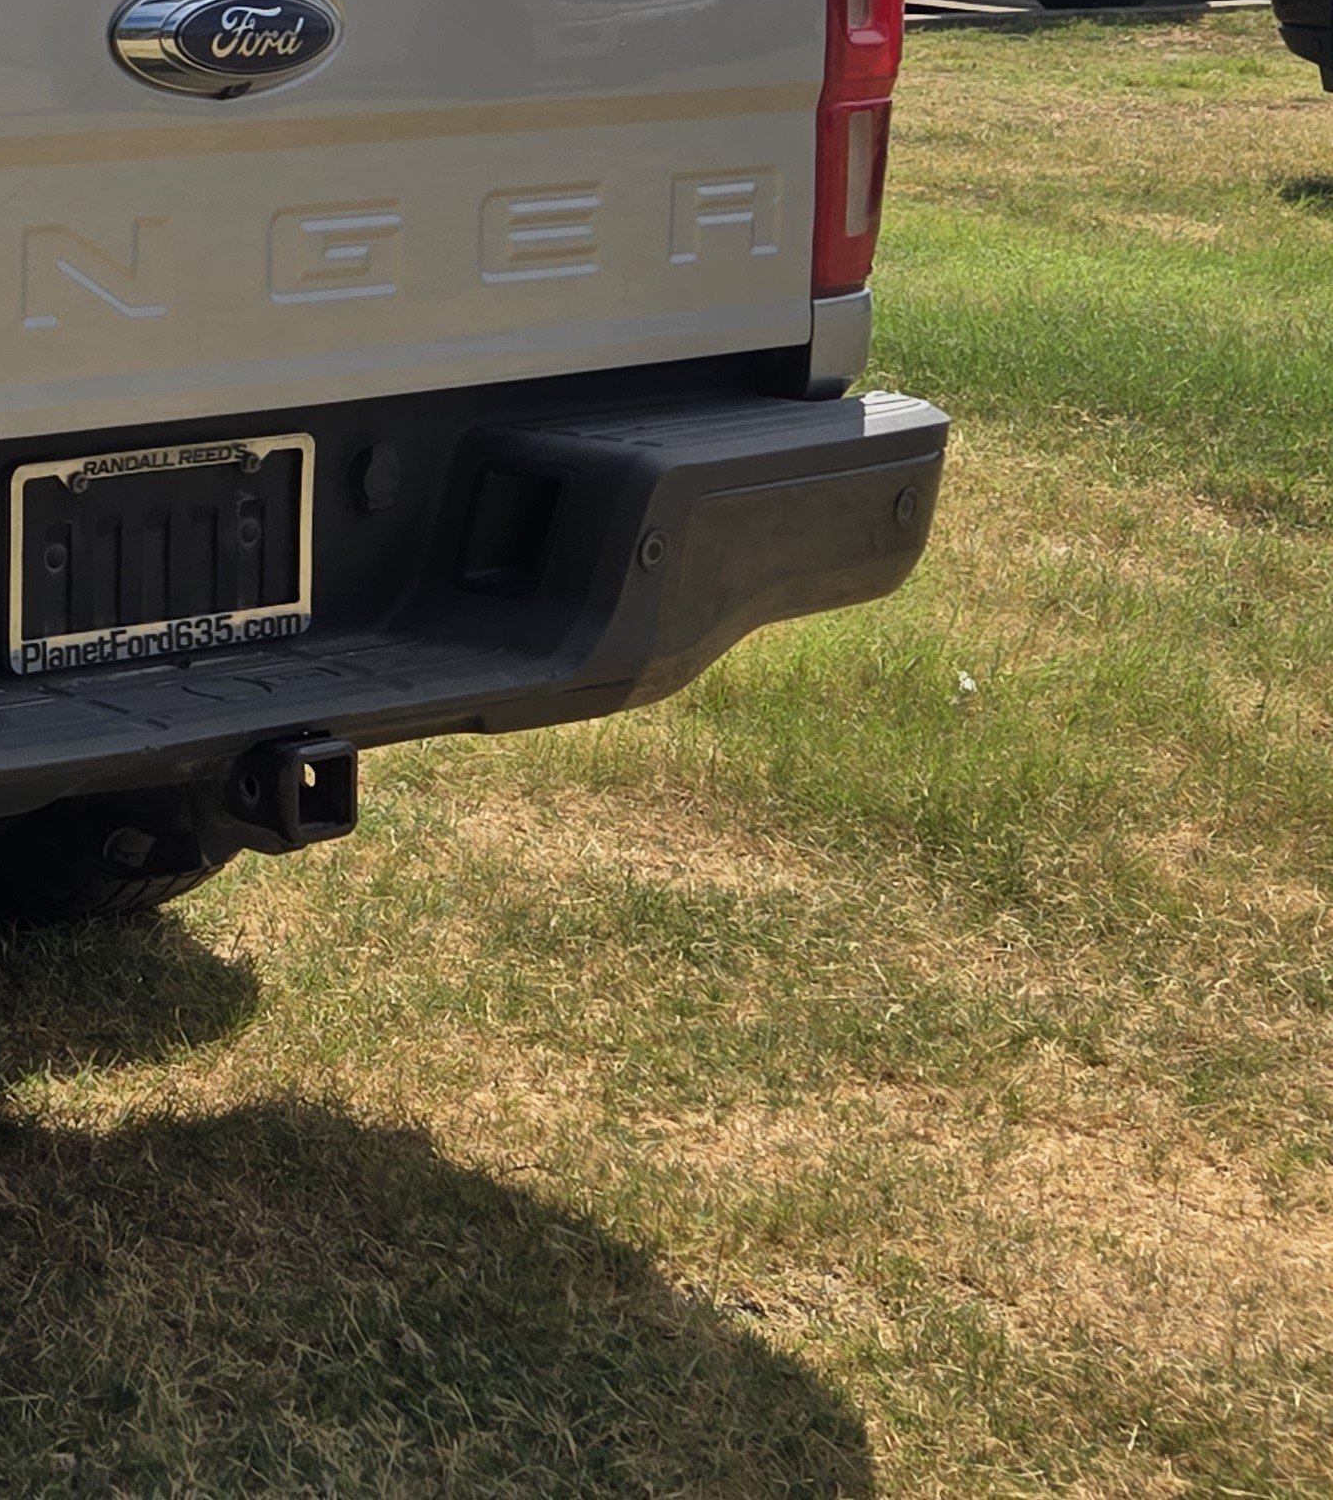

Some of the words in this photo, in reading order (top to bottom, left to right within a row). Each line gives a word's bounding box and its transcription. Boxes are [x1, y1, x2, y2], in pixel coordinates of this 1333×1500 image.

[211, 6, 304, 58] Ford
[83, 451, 175, 476] RANDALL
[21, 613, 302, 673] PlanetFord635.com
